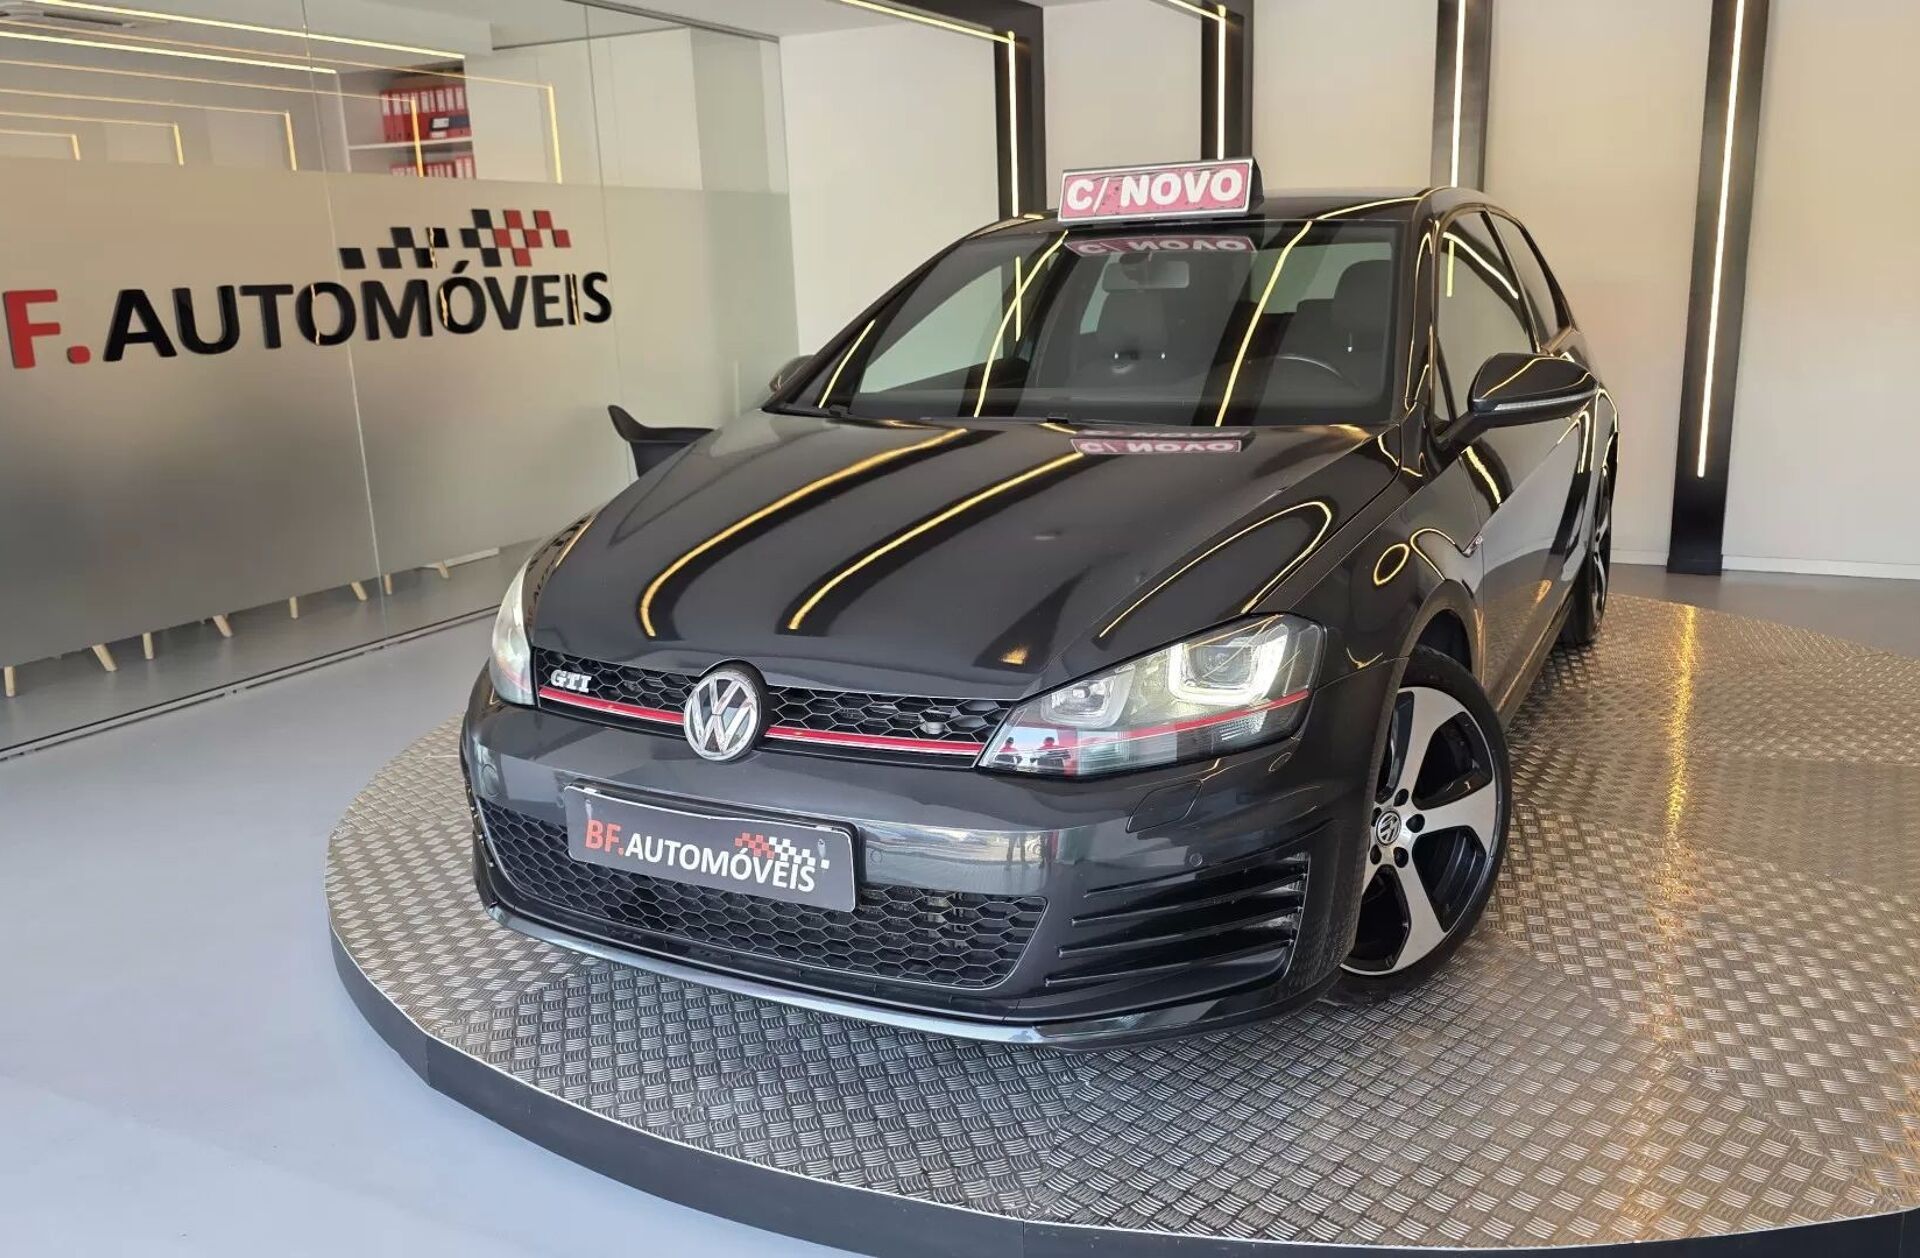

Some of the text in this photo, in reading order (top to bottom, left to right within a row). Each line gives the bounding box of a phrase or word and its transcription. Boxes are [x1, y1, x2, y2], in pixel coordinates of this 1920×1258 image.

[1066, 168, 1243, 213] C/ NOVO
[550, 669, 592, 694] GTI
[585, 818, 816, 893] BF.AUTOMÓVEIS
